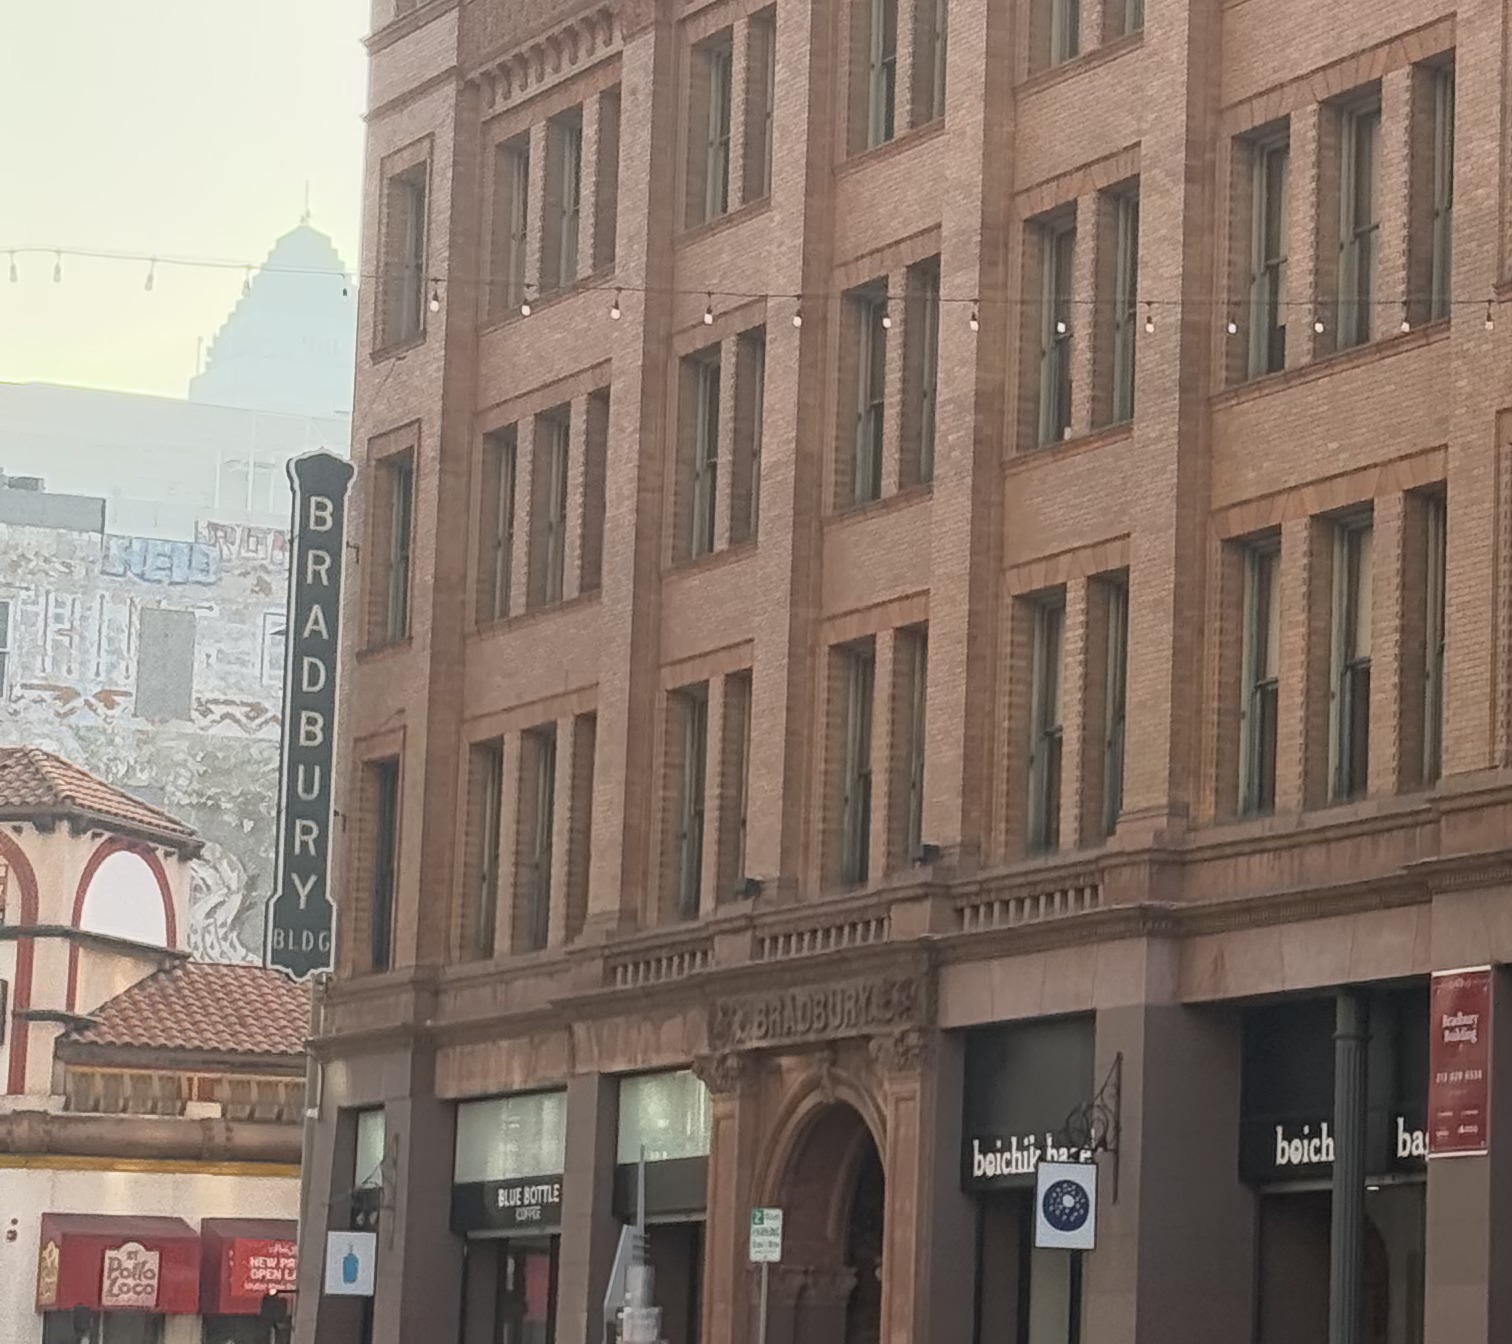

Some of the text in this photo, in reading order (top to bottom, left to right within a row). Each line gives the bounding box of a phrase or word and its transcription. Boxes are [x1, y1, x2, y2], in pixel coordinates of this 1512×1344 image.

[290, 495, 335, 911] BRADBURY
[272, 926, 330, 954] BLDG
[754, 983, 874, 1040] BRADBURY
[1442, 1011, 1480, 1029] Bradbury
[497, 1183, 561, 1209] BLUE BOTTLE
[106, 1256, 157, 1281] Pollo
[249, 1256, 278, 1268] NEW
[250, 1268, 282, 1281] OPEN
[105, 1275, 155, 1298] Loco
